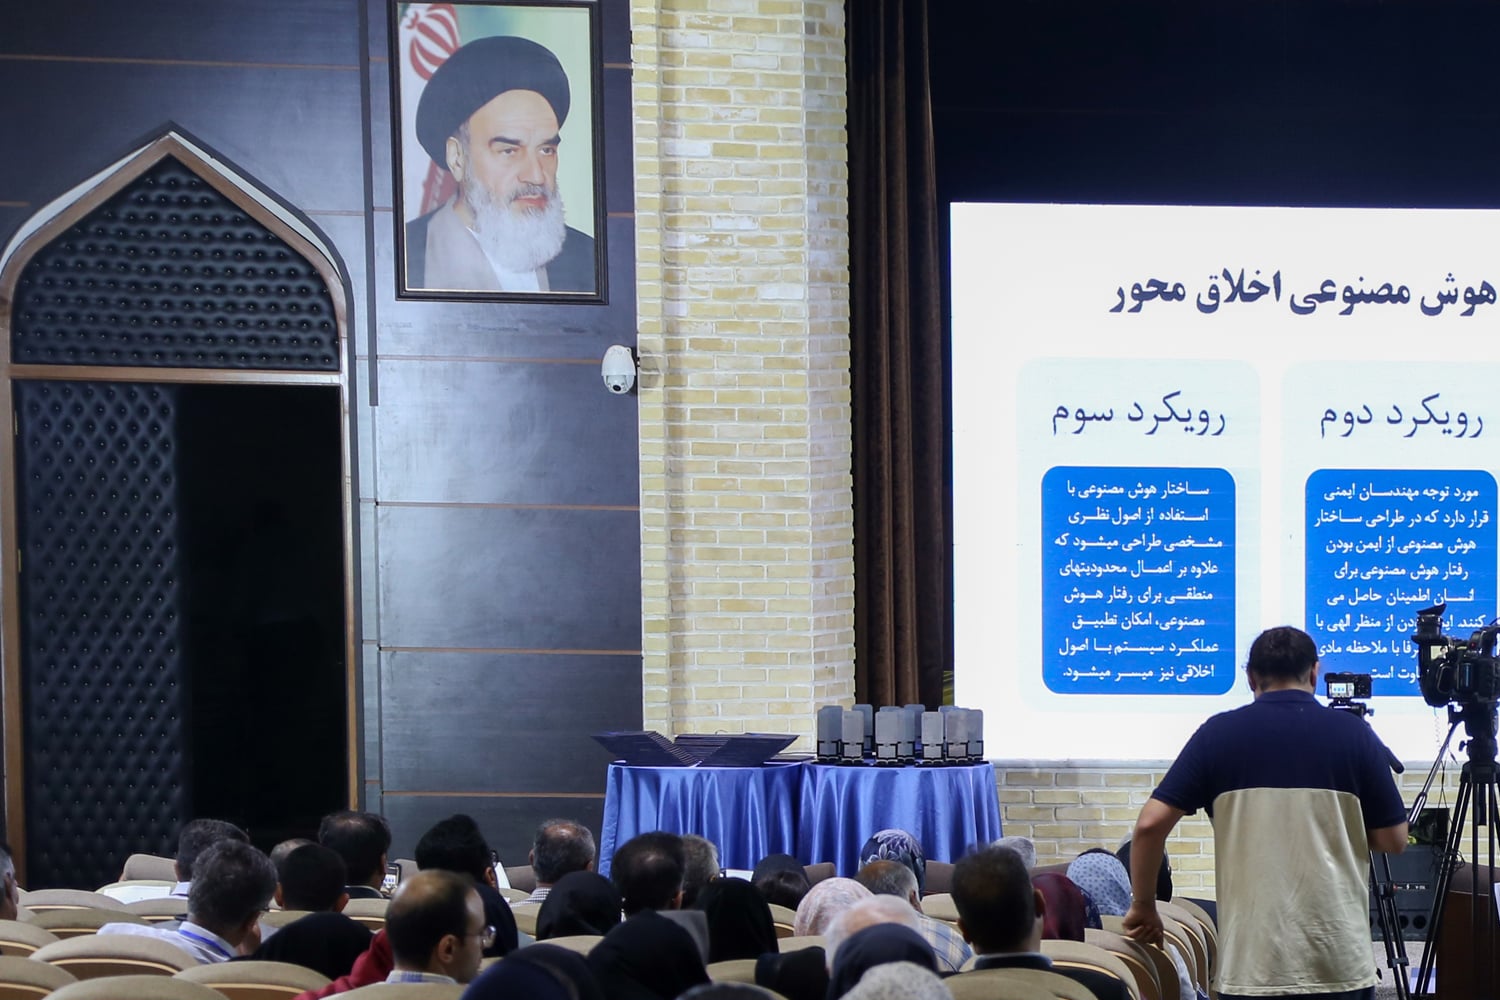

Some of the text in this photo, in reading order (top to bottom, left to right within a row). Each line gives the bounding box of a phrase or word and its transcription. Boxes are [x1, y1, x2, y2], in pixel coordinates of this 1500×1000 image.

[1110, 279, 1185, 312] محور
[1197, 268, 1281, 313] اخلاق
[1290, 277, 1410, 315] مصنوعی
[1421, 278, 1496, 316] هوش
[1053, 391, 1225, 435] رویکرد سوم
[1321, 393, 1482, 438] رویکرد دوم
